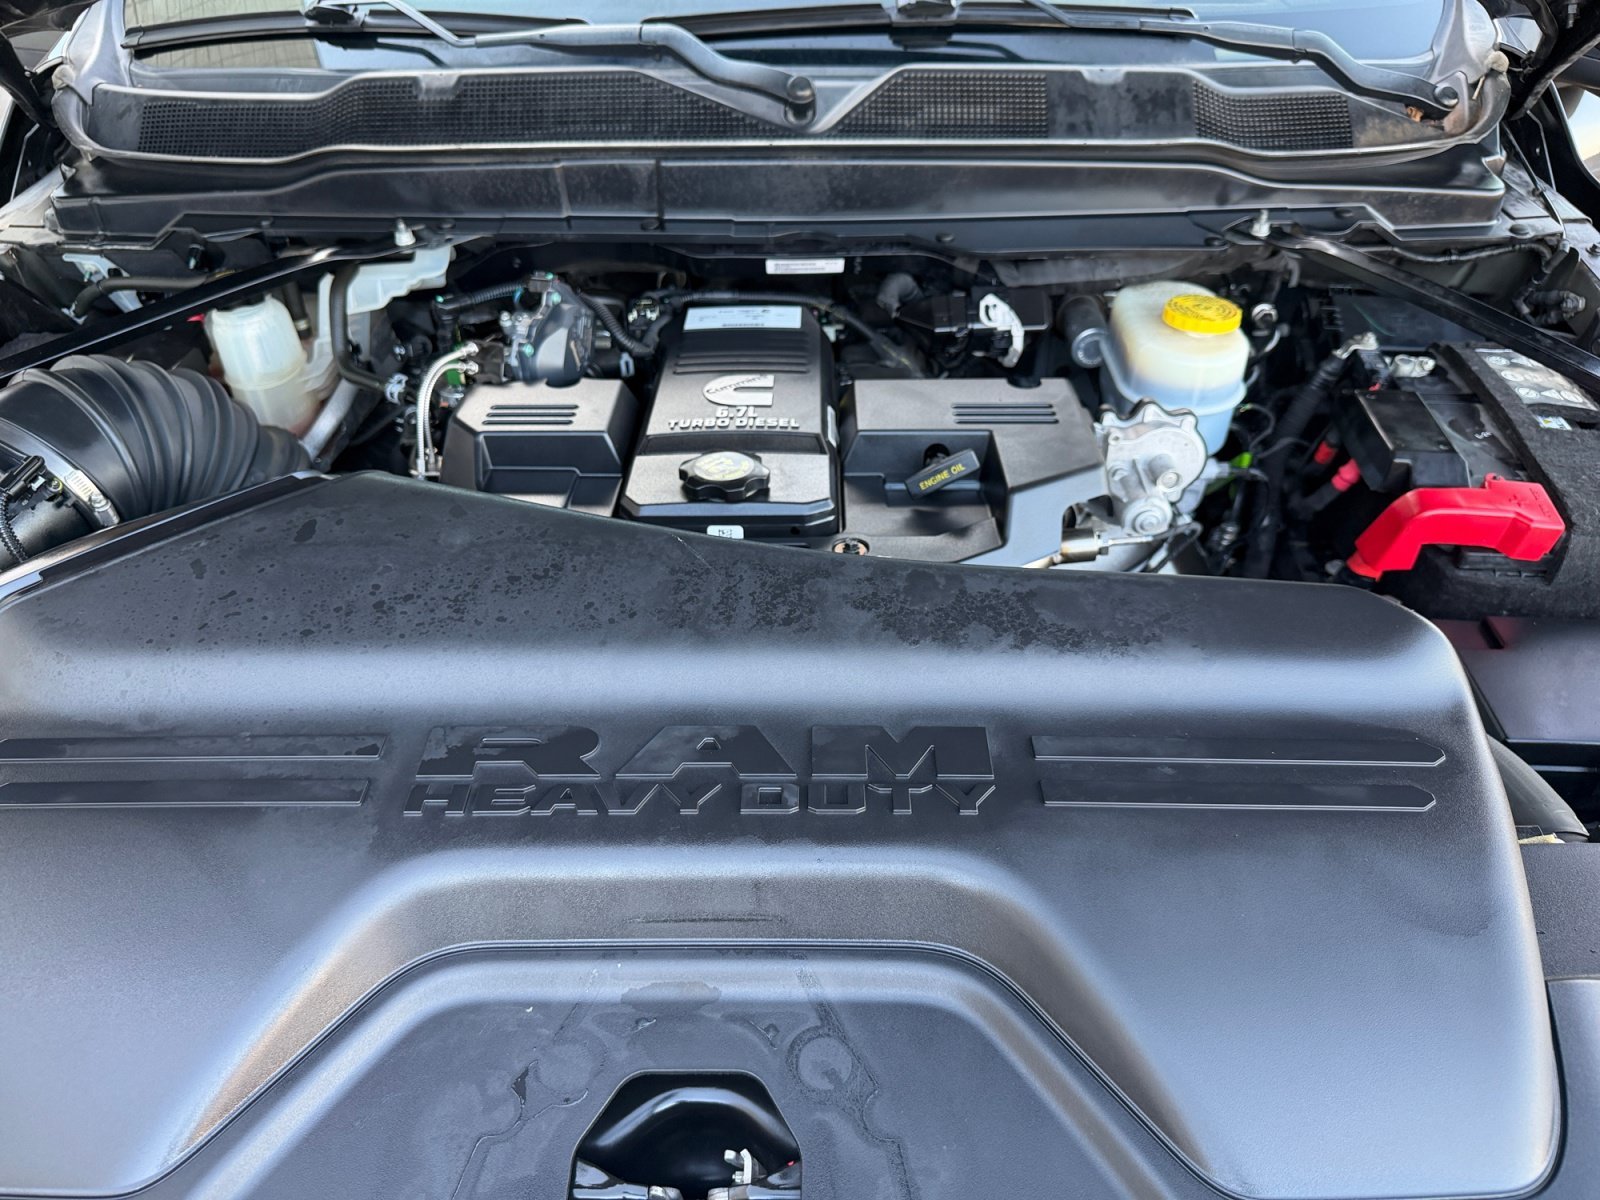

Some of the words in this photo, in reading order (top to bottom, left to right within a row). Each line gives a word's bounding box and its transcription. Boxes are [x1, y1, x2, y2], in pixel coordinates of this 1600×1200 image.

[668, 418, 730, 429] TURBO
[734, 417, 800, 429] DIESEL
[715, 405, 758, 418] 6.7L
[919, 469, 951, 490] ENGINE
[950, 463, 966, 475] OIL
[415, 725, 995, 779] RAM
[403, 783, 723, 816] HEAVY
[740, 783, 996, 815] DUTY
